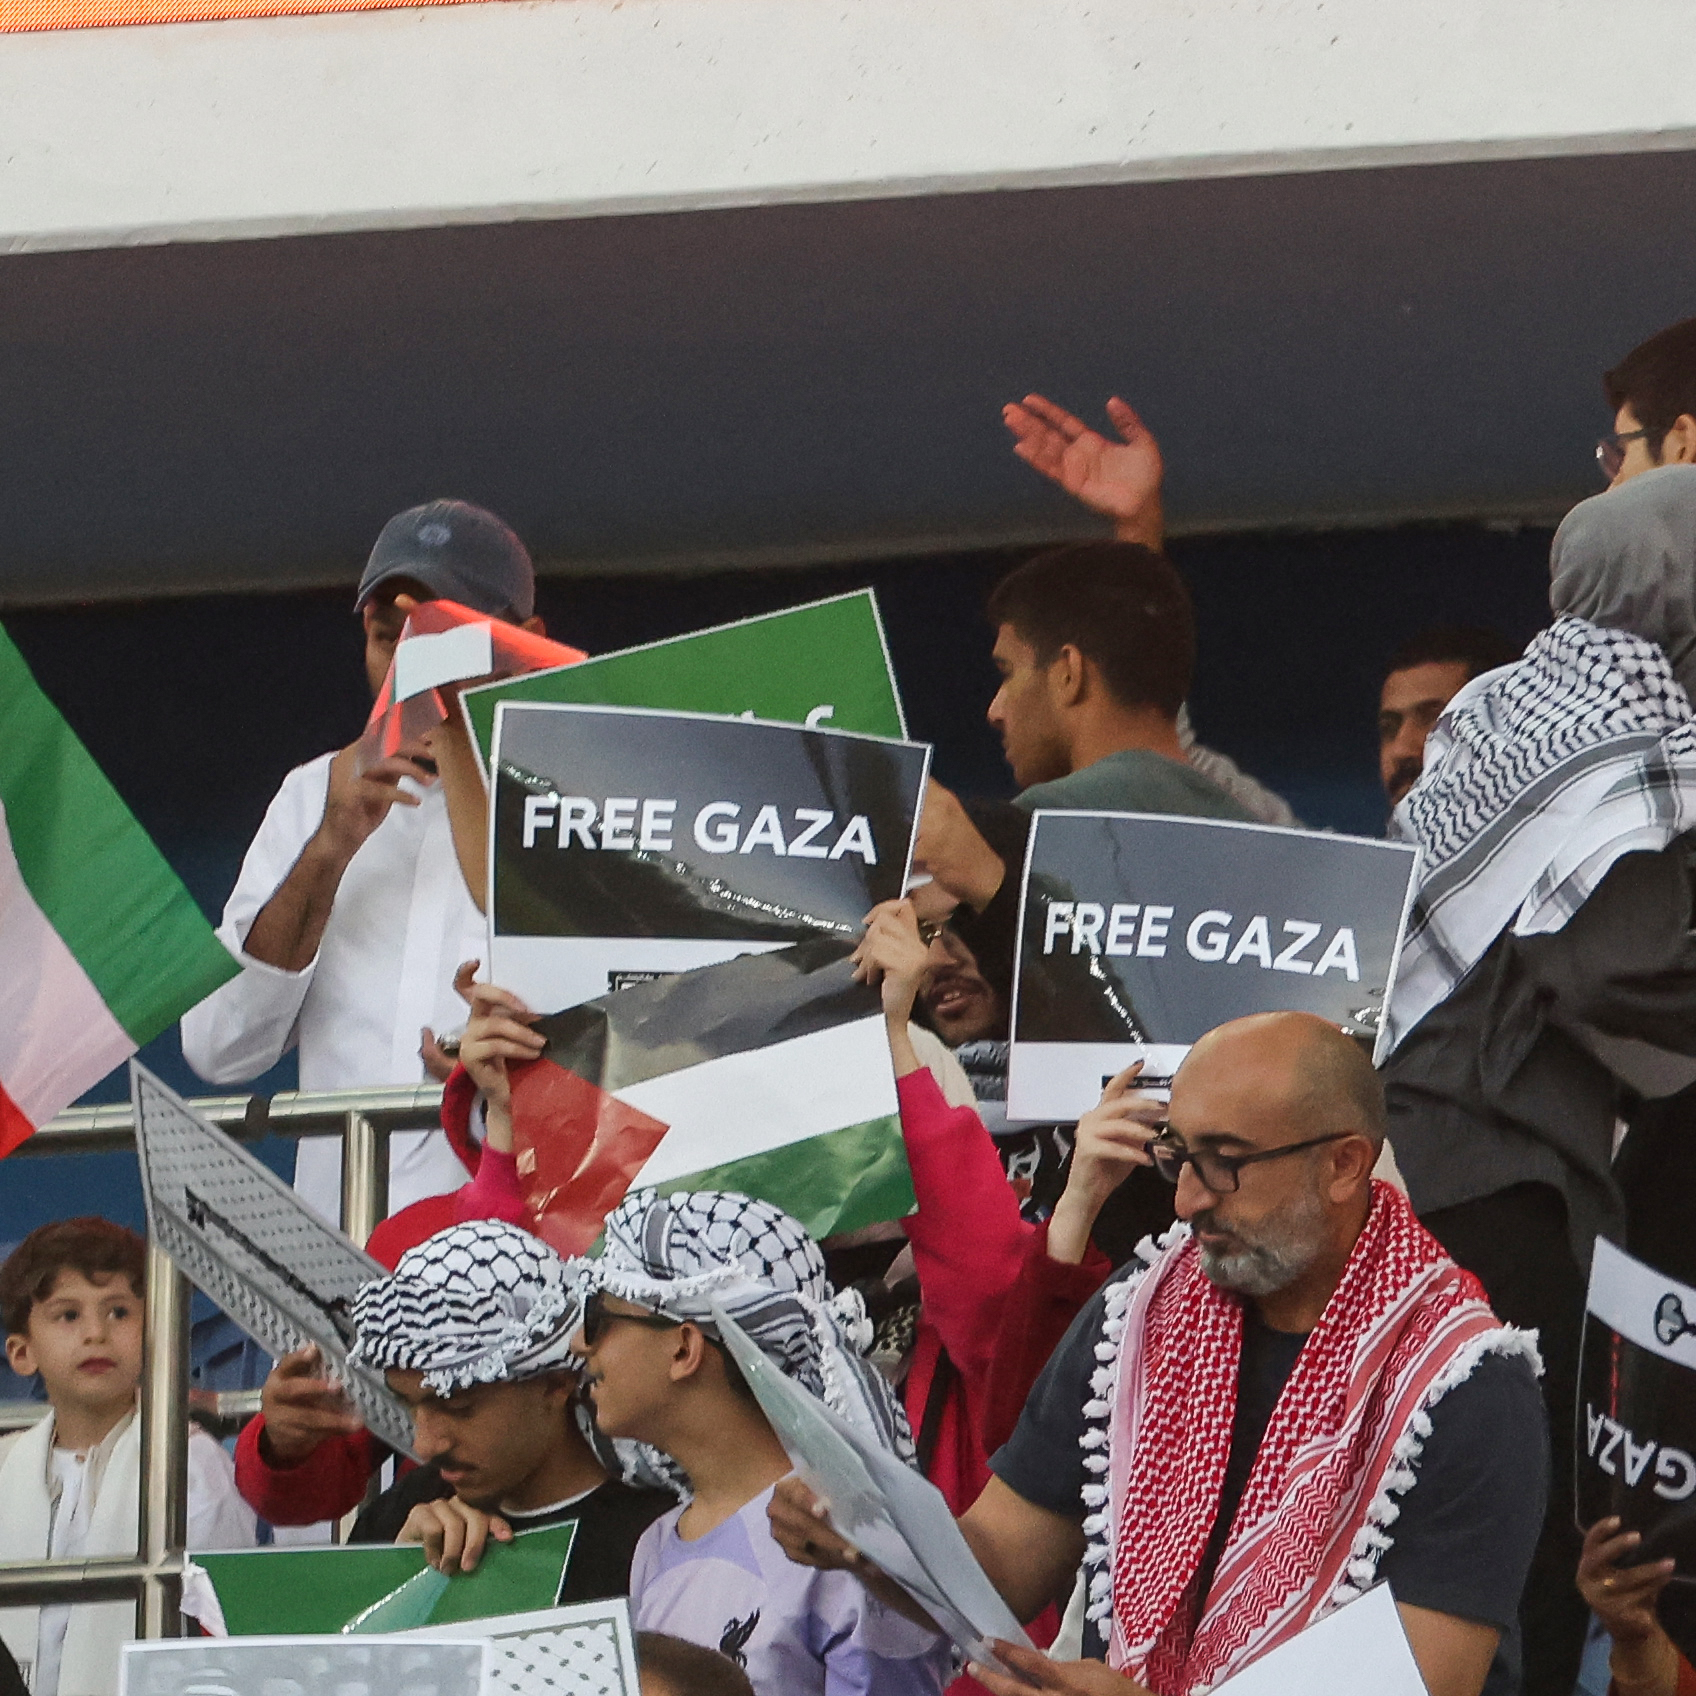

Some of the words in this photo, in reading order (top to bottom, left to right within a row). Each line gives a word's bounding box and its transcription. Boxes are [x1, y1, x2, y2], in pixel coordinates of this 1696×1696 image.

[523, 796, 677, 850] FREE
[693, 800, 879, 866] GAZA
[1043, 901, 1175, 958] FREE
[1186, 909, 1361, 983] GAZA
